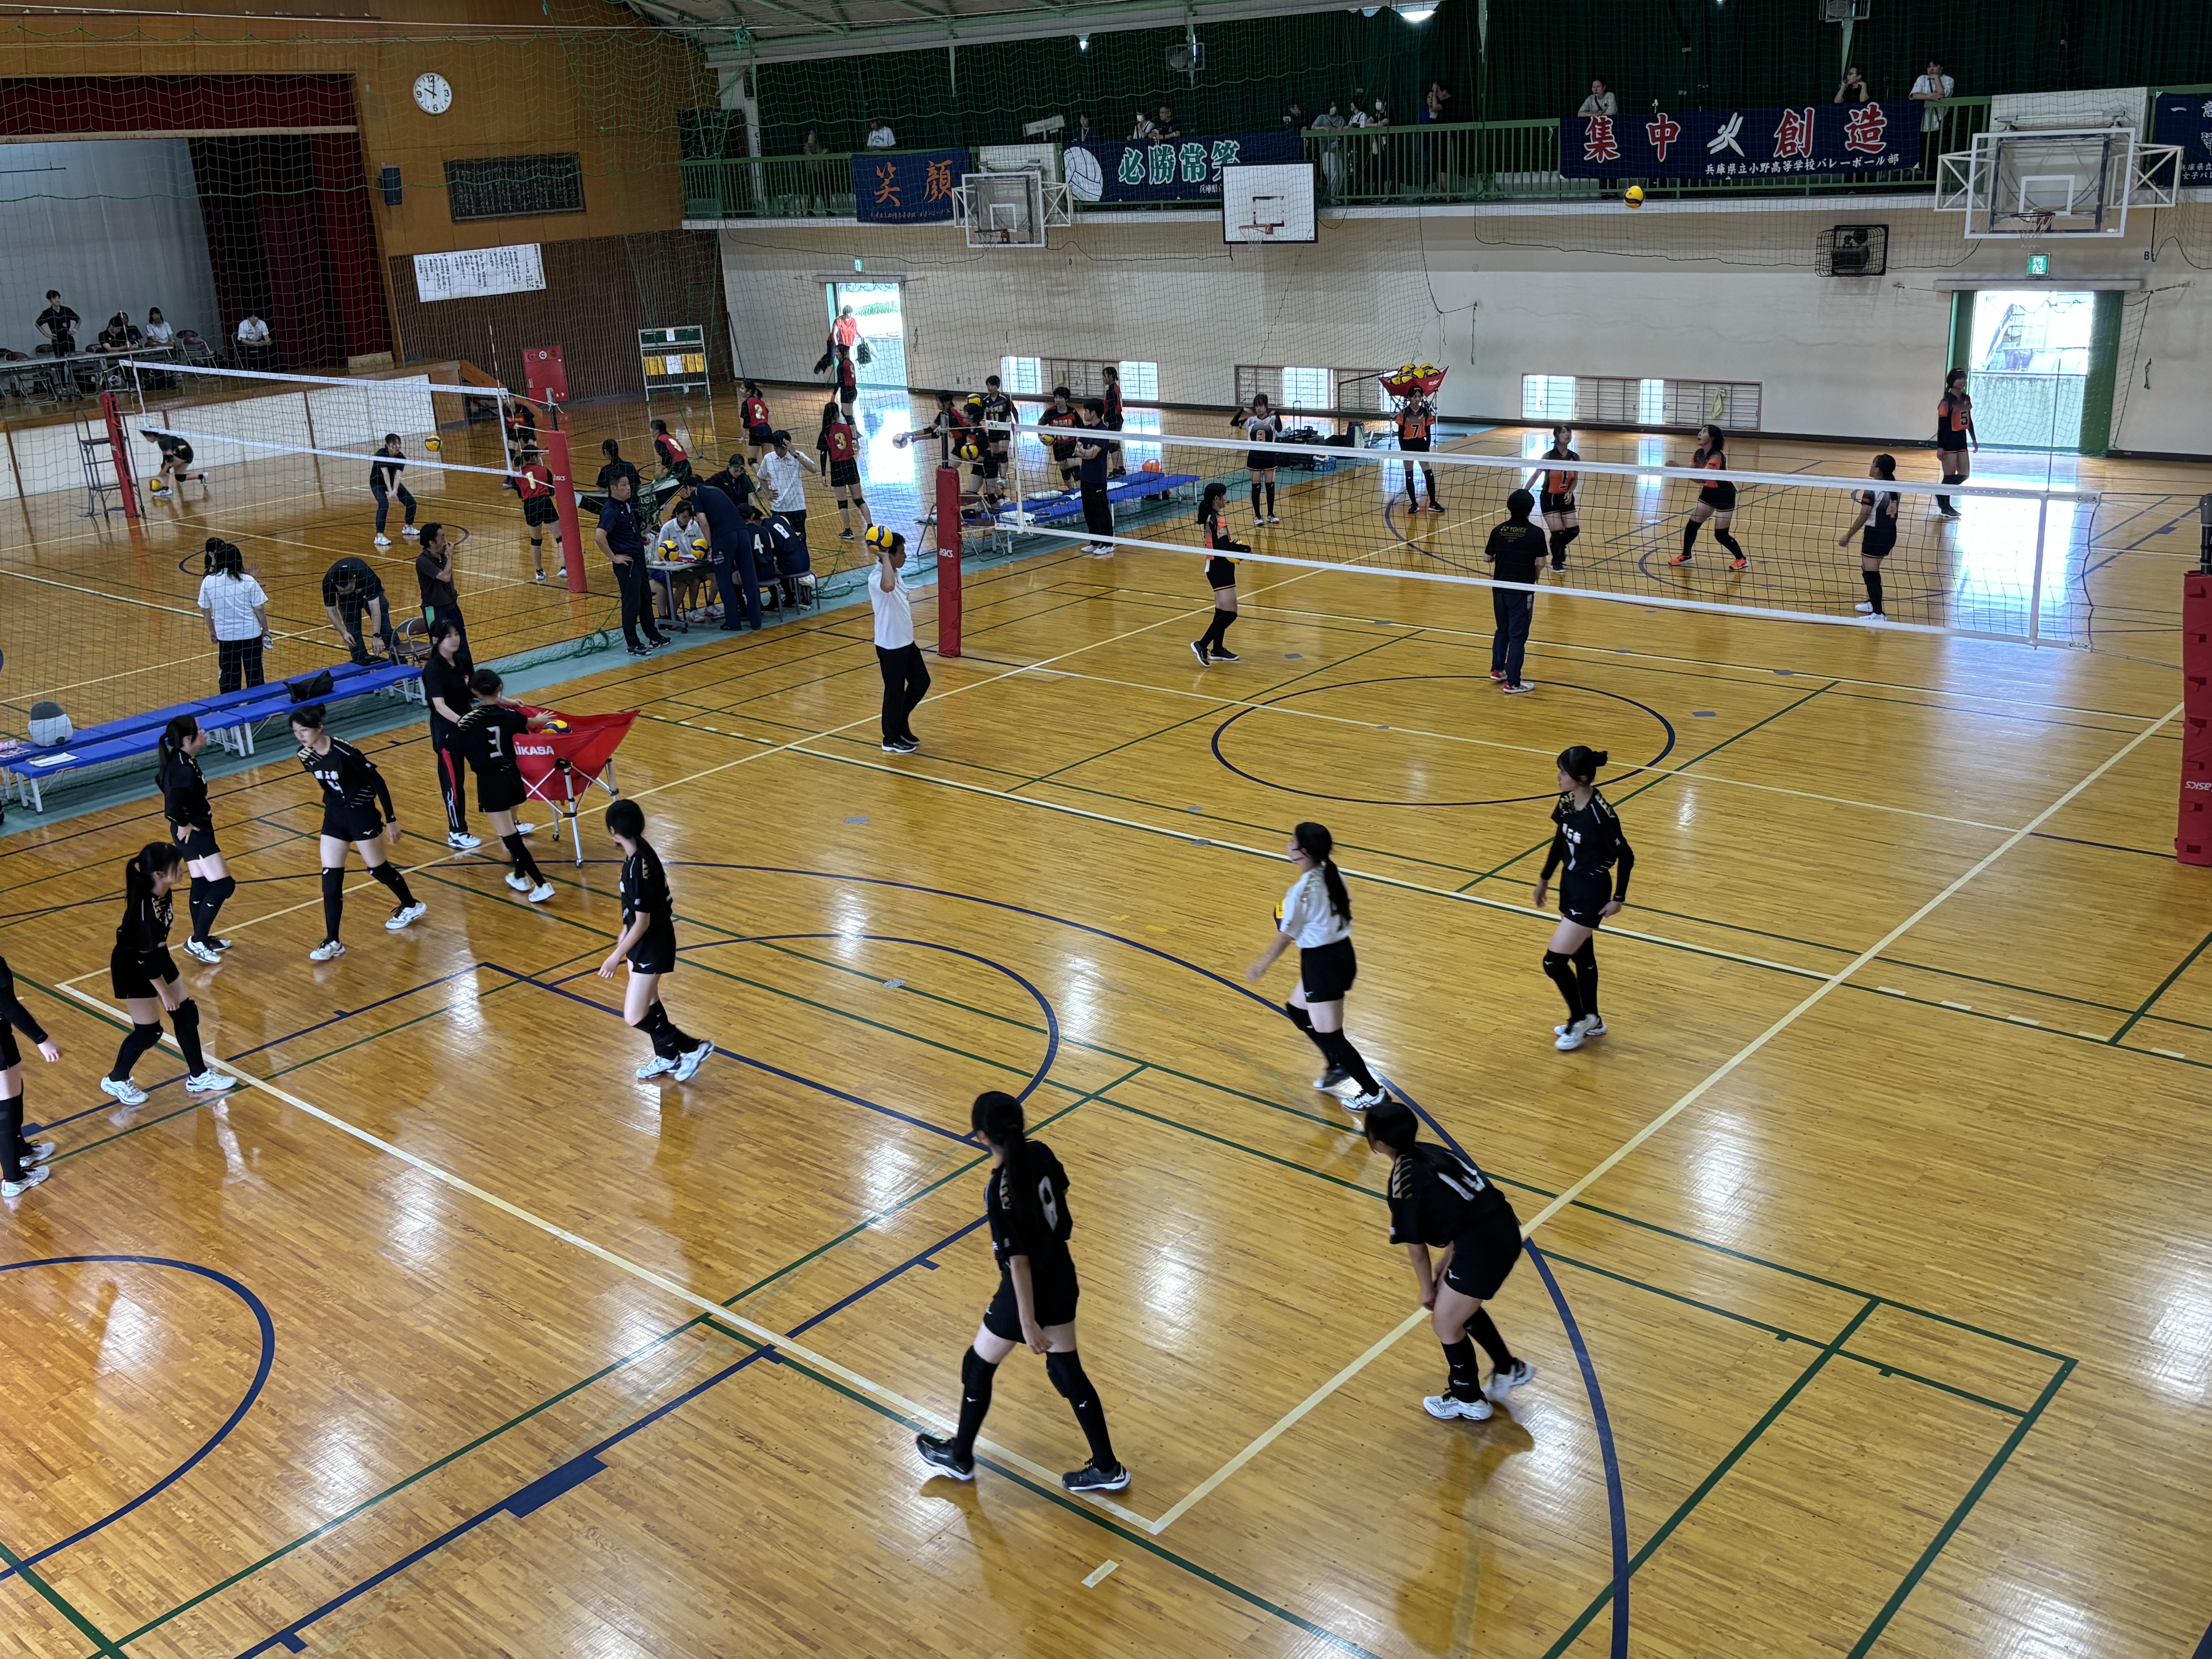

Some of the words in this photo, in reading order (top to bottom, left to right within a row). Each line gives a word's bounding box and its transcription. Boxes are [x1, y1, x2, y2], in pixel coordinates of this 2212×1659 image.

[1583, 113, 1681, 163] 集中
[1773, 102, 1887, 158] 創造
[874, 160, 953, 207] 笑顔
[2143, 251, 2150, 260] B
[755, 404, 765, 419] 2
[1960, 410, 1968, 425] 5
[1412, 424, 1419, 438] 7
[835, 433, 847, 450] 3
[641, 494, 656, 504] ten
[773, 523, 790, 539] 8
[754, 534, 764, 554] 4
[514, 742, 554, 755] IKASA
